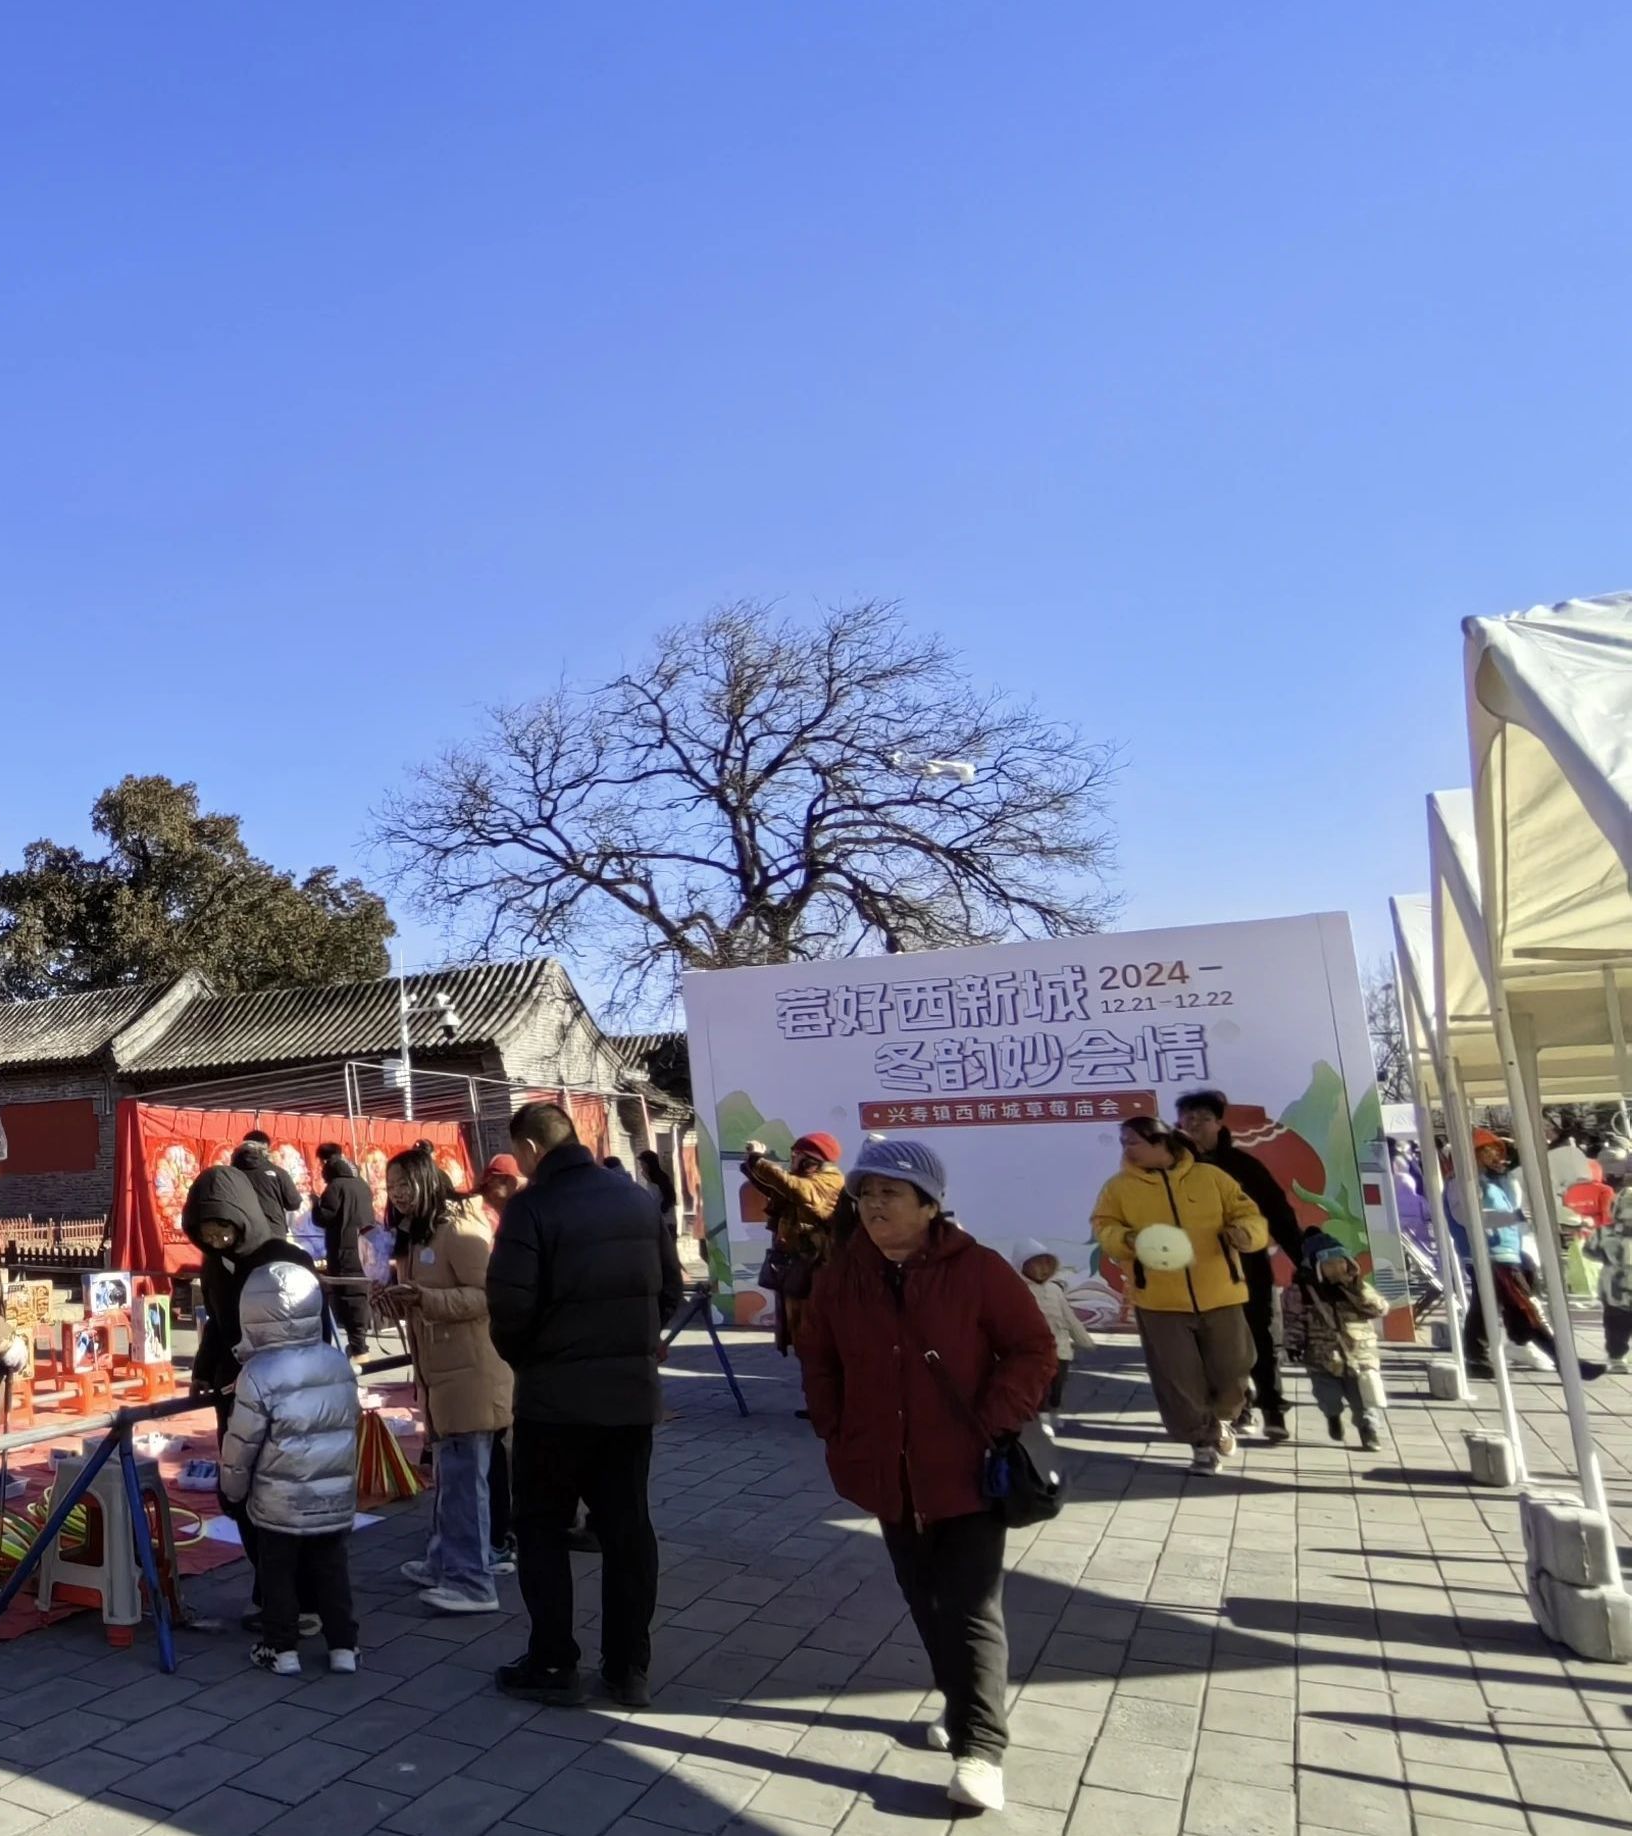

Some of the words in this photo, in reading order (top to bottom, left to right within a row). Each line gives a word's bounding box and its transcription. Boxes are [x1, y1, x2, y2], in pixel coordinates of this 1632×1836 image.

[775, 965, 1091, 1039] 莓好西新城
[875, 1023, 1208, 1092] 冬韵妙会情
[887, 1099, 1119, 1123] 兴寿镇西新城草莓庙会
